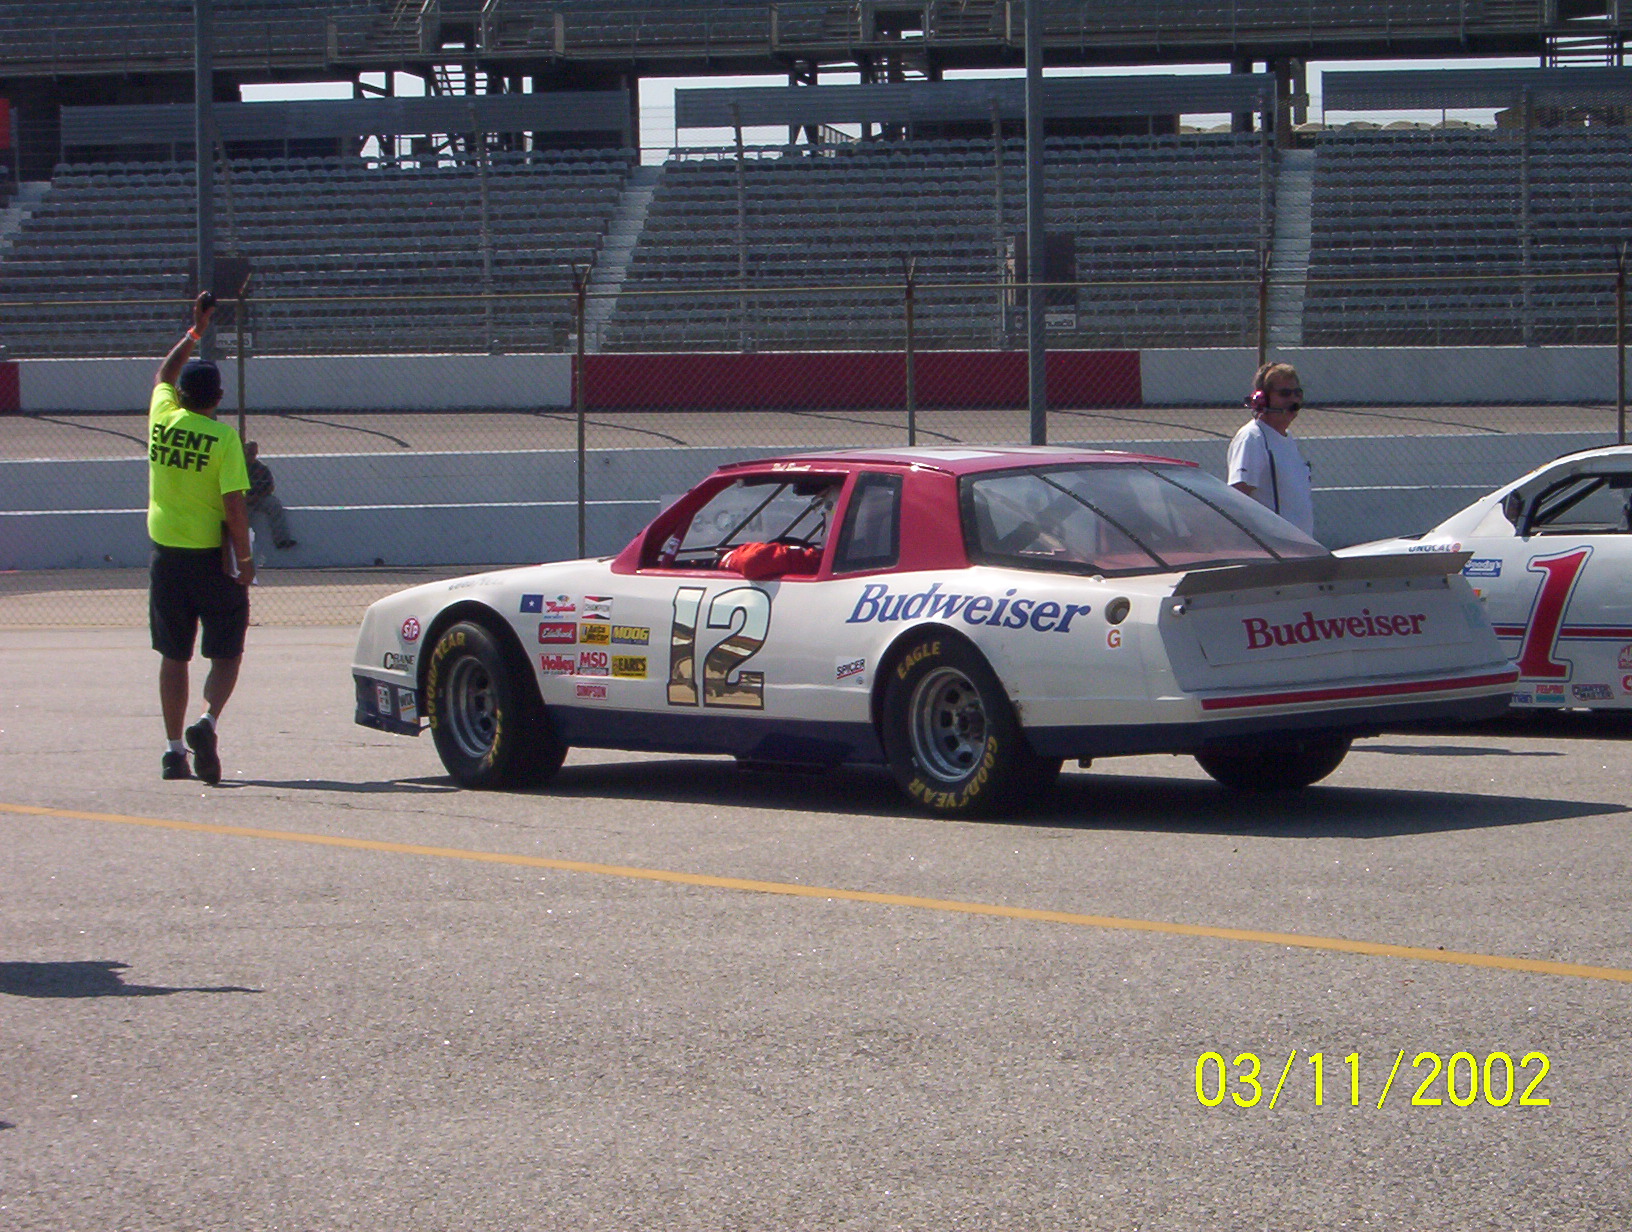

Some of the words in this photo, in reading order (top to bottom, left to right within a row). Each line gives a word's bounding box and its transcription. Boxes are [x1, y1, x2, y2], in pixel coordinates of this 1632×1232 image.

[152, 423, 219, 453] EVENT
[150, 443, 210, 472] STAFF
[846, 583, 1092, 633] Budweiser
[1507, 545, 1594, 683] 1
[402, 619, 419, 639] STP
[612, 626, 650, 641] MOOG
[1107, 629, 1122, 648] G
[1241, 607, 1427, 650] Budweiser
[580, 651, 608, 668] MSD
[667, 586, 772, 710] 12
[383, 652, 416, 670] CRANE
[541, 655, 575, 675] Holley
[836, 658, 866, 677] SPICER
[897, 641, 941, 680] EAGLE
